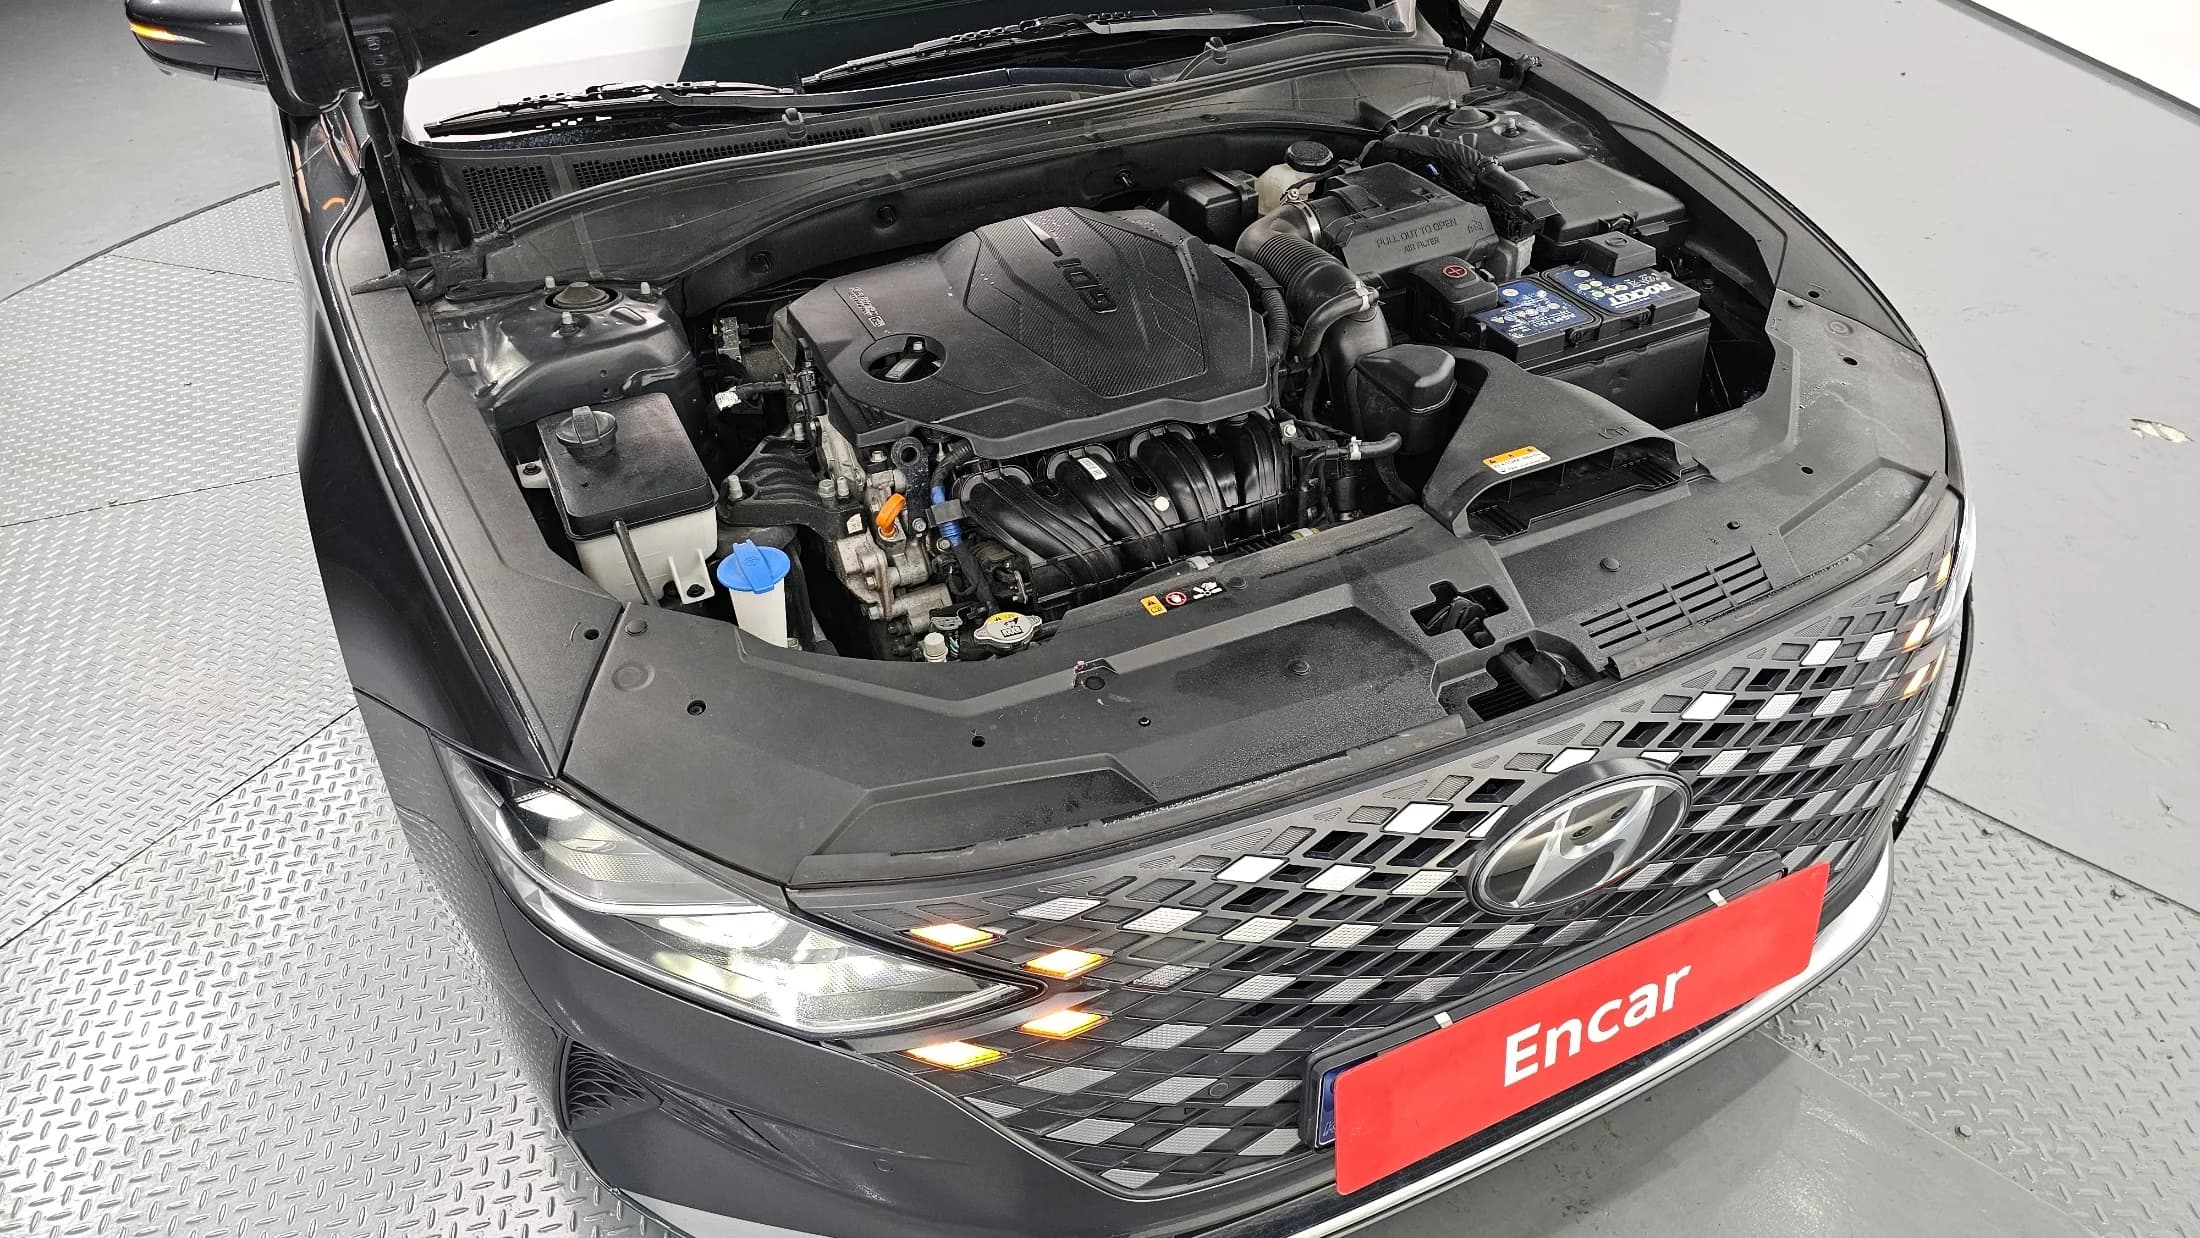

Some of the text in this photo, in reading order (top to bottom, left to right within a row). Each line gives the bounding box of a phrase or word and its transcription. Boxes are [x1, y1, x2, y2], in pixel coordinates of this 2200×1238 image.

[1376, 218, 1458, 248] PULL OUT TO OPEN
[1417, 236, 1440, 249] FILTER
[1610, 281, 1675, 307] ROCKET
[1504, 965, 1692, 1088] Encar
